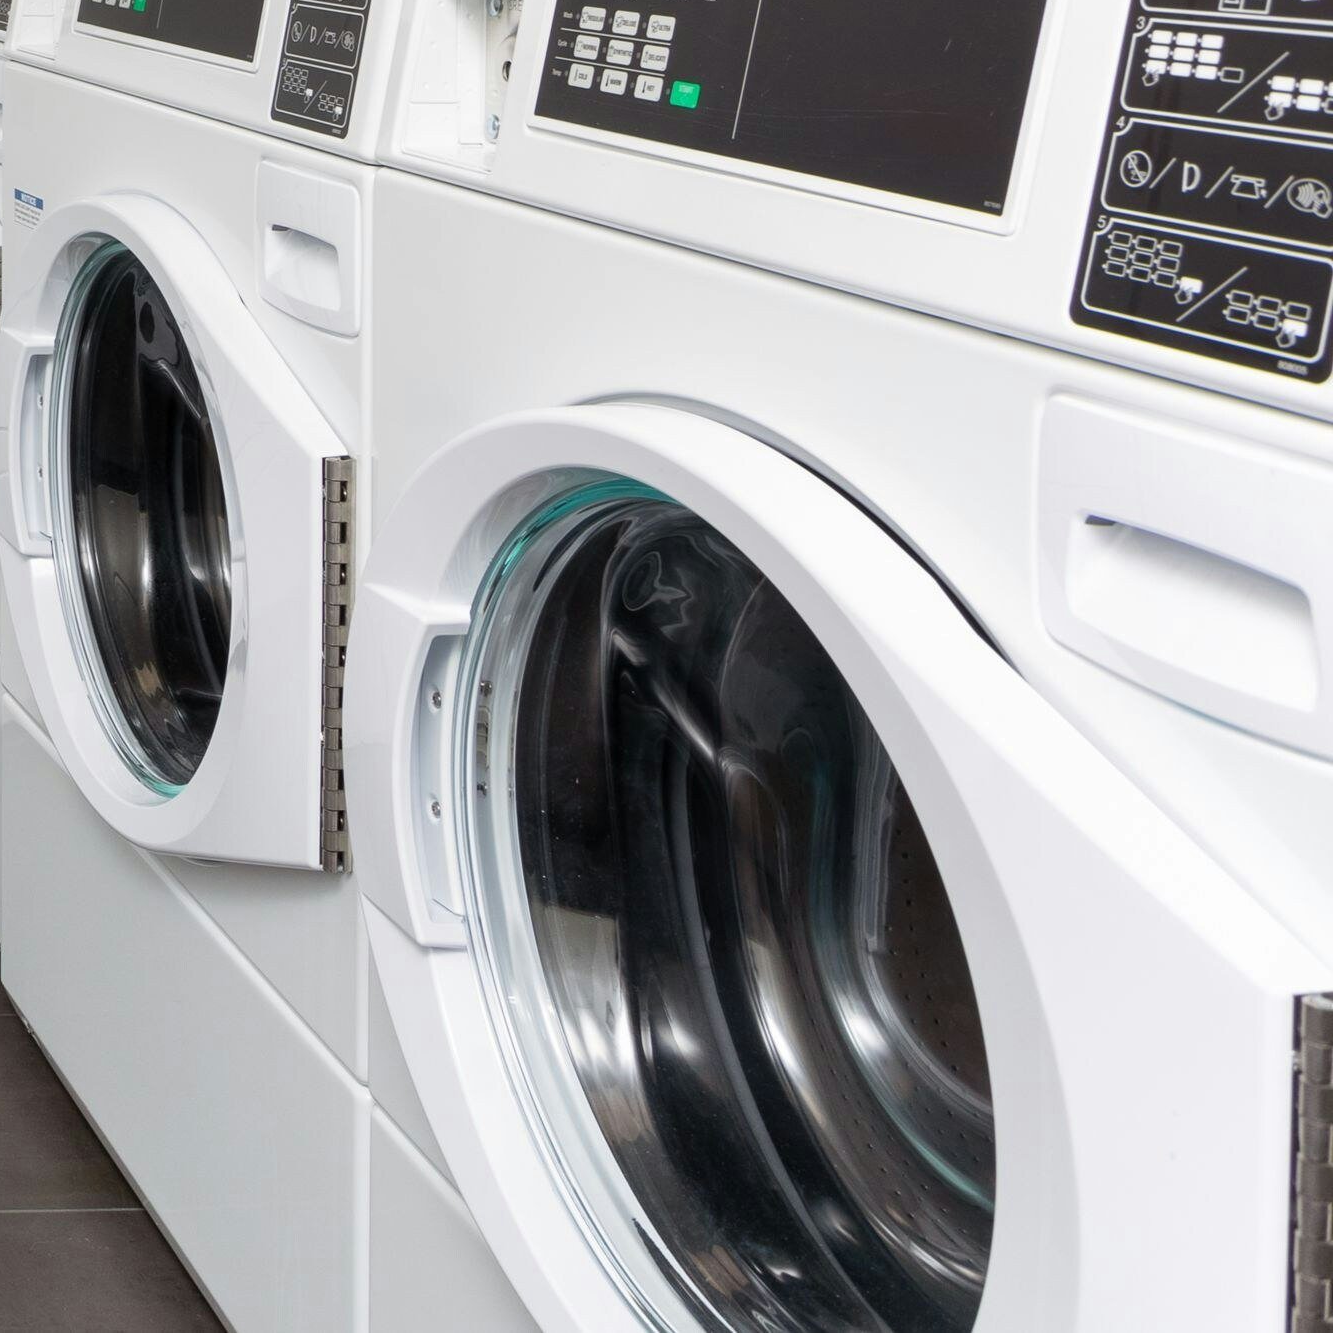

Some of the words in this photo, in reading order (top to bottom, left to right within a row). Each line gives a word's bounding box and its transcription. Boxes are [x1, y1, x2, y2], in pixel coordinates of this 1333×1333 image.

[1135, 16, 1146, 30] 3
[1116, 116, 1126, 129] 4
[1096, 215, 1107, 229] 5
